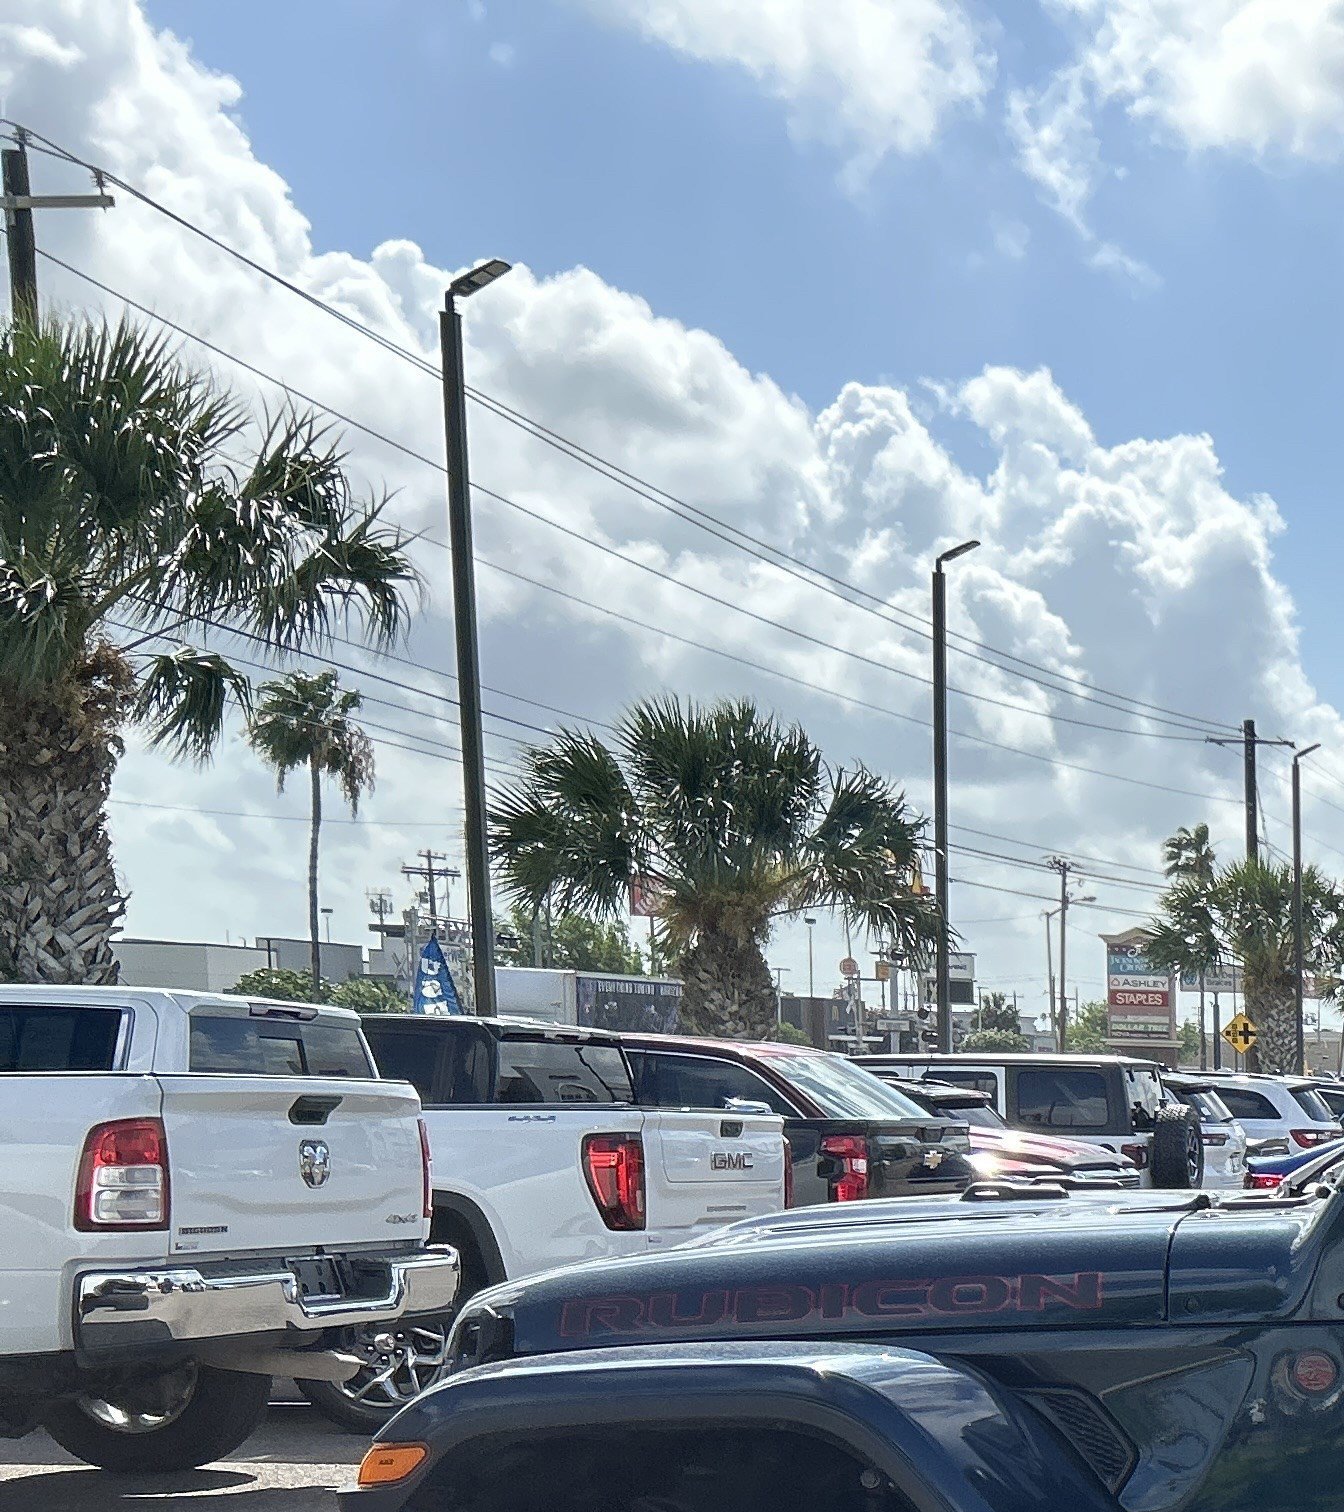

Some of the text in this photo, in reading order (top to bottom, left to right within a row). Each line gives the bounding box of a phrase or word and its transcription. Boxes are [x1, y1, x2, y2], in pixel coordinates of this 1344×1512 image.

[1121, 979, 1167, 989] ASHLEY
[1115, 992, 1163, 1006] STAPLES
[711, 1152, 754, 1170] GMC
[560, 1271, 1104, 1338] RUBICON
